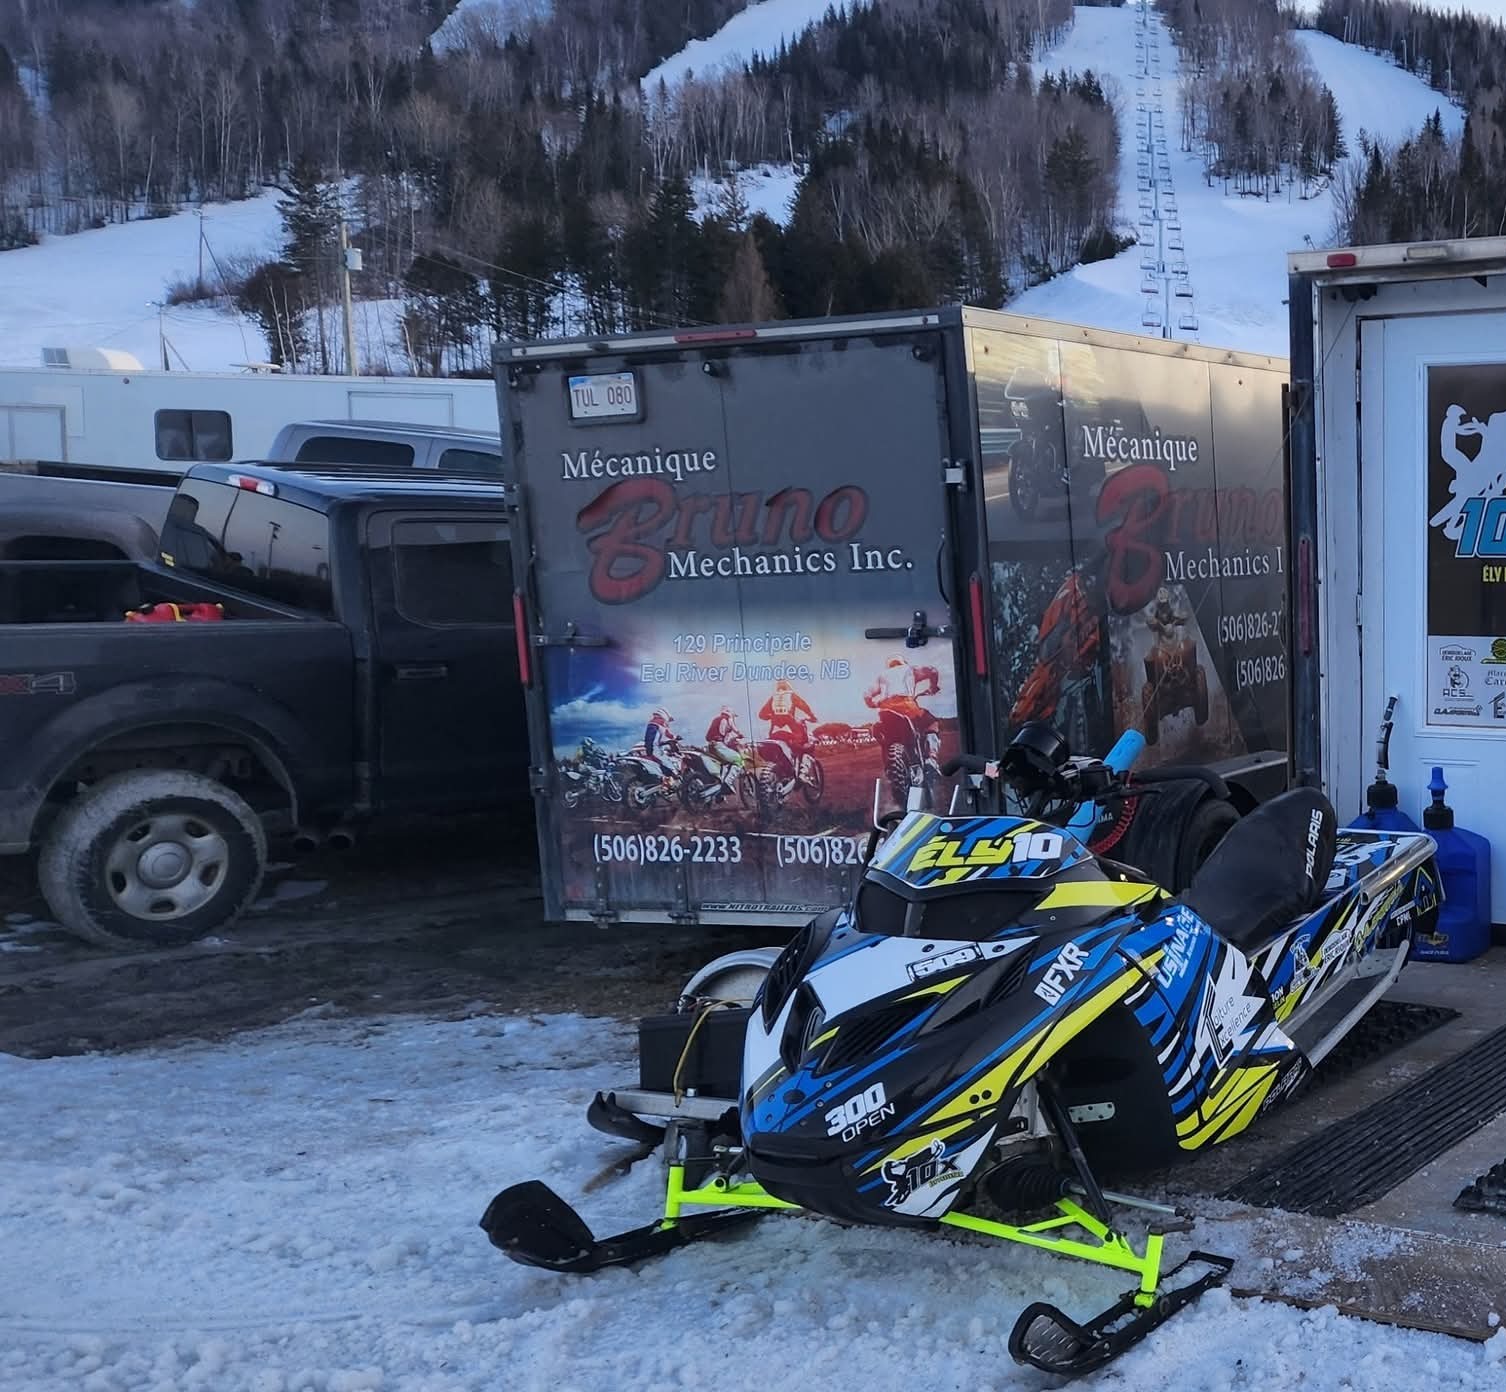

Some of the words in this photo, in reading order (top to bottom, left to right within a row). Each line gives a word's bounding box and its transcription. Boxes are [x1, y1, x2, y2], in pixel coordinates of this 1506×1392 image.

[573, 387, 599, 408] TUL
[607, 385, 632, 405] 080
[562, 447, 717, 481] Mécanique
[1082, 425, 1199, 470] Mécanique
[576, 477, 870, 605] Bruno
[668, 545, 837, 579] Mechanics
[850, 542, 913, 571] Inc.
[1165, 548, 1271, 581] Mechanics
[1482, 565, 1503, 582] ÉLY
[673, 633, 706, 654] 129
[712, 630, 812, 657] Principale
[640, 662, 671, 683] Eel
[675, 660, 727, 682] River
[732, 659, 815, 683] Dundee,
[820, 658, 850, 681] NB
[593, 833, 742, 866] (506)826-2233
[1305, 808, 1323, 880] POLARIS
[913, 946, 978, 979] 509
[1156, 906, 1196, 989] USINAGE
[1042, 942, 1090, 995] FXR
[824, 1082, 887, 1137] 300
[841, 1102, 896, 1143] OPEN
